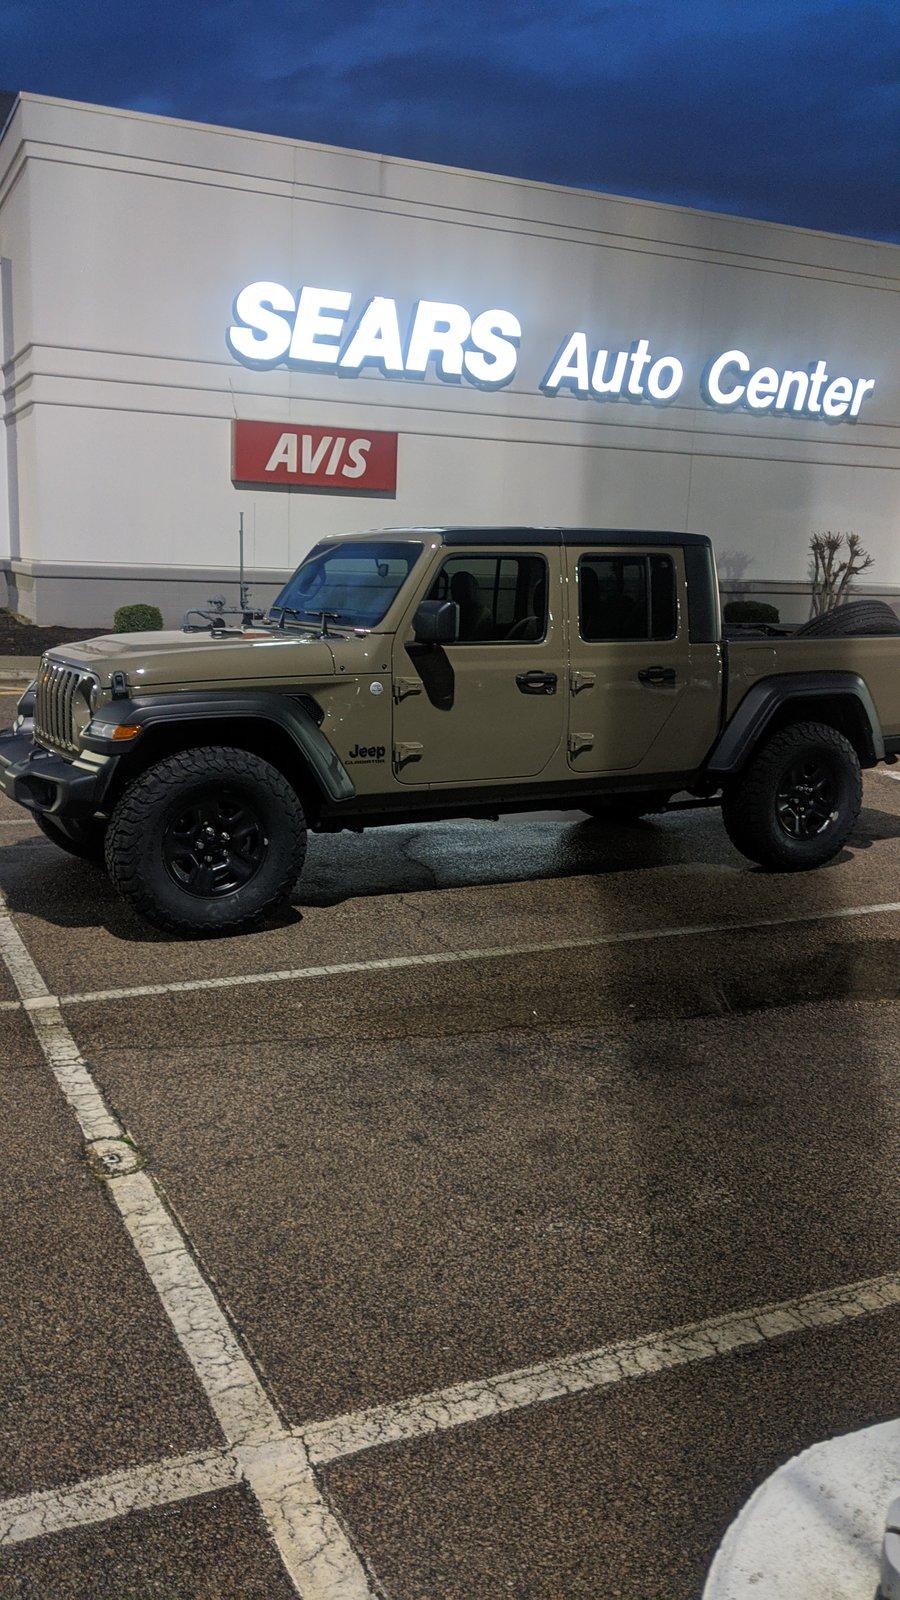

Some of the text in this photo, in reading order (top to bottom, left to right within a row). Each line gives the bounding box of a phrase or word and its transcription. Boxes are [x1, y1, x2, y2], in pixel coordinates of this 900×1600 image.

[229, 281, 876, 417] SEARS Auto Center
[264, 432, 372, 479] AVIS
[349, 744, 386, 759] Jeep
